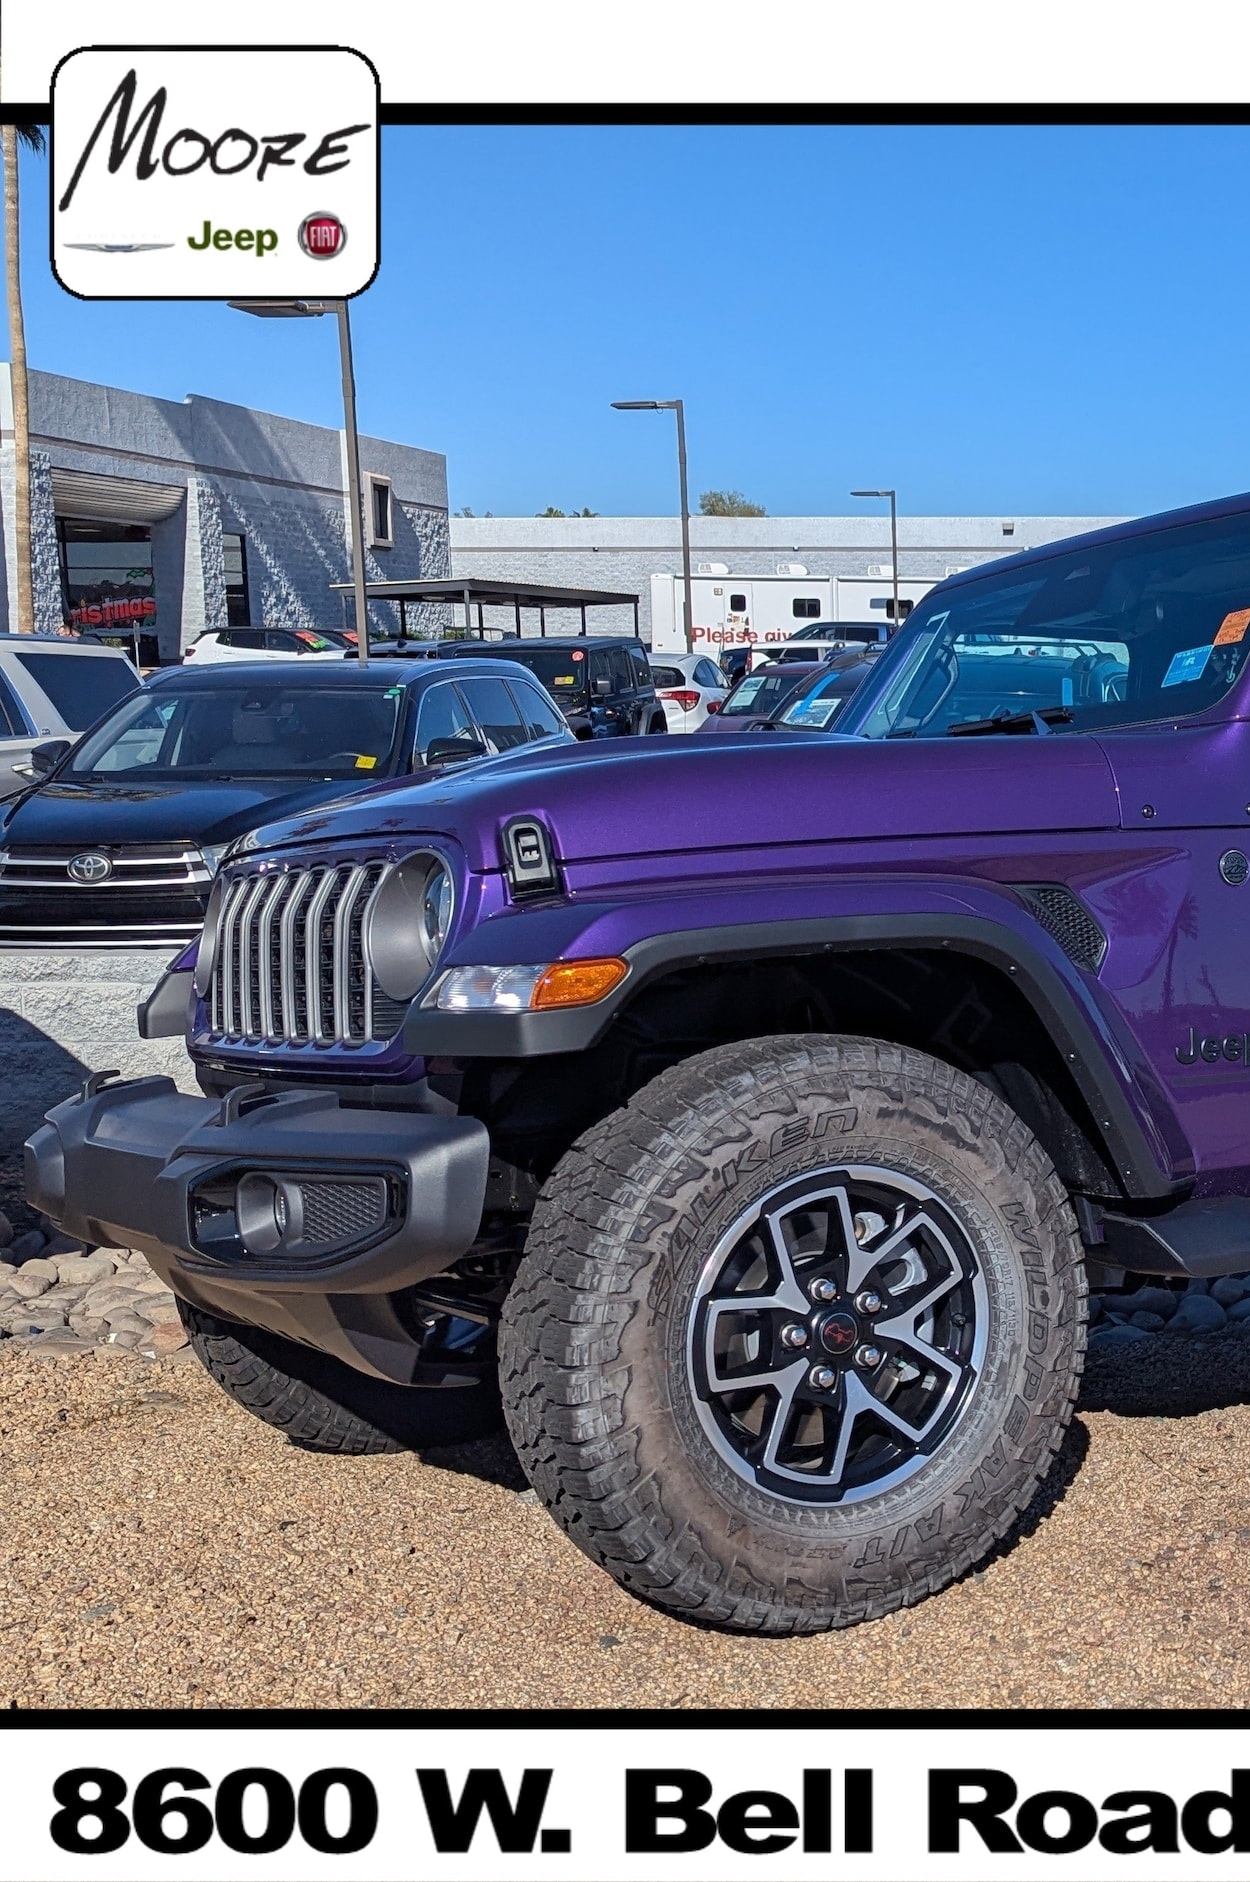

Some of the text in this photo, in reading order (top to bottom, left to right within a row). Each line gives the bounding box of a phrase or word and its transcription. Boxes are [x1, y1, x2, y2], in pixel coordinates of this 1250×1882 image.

[690, 627, 758, 644] Please
[953, 1201, 1051, 1517] WILDPEAK
[853, 1500, 945, 1569] A/T
